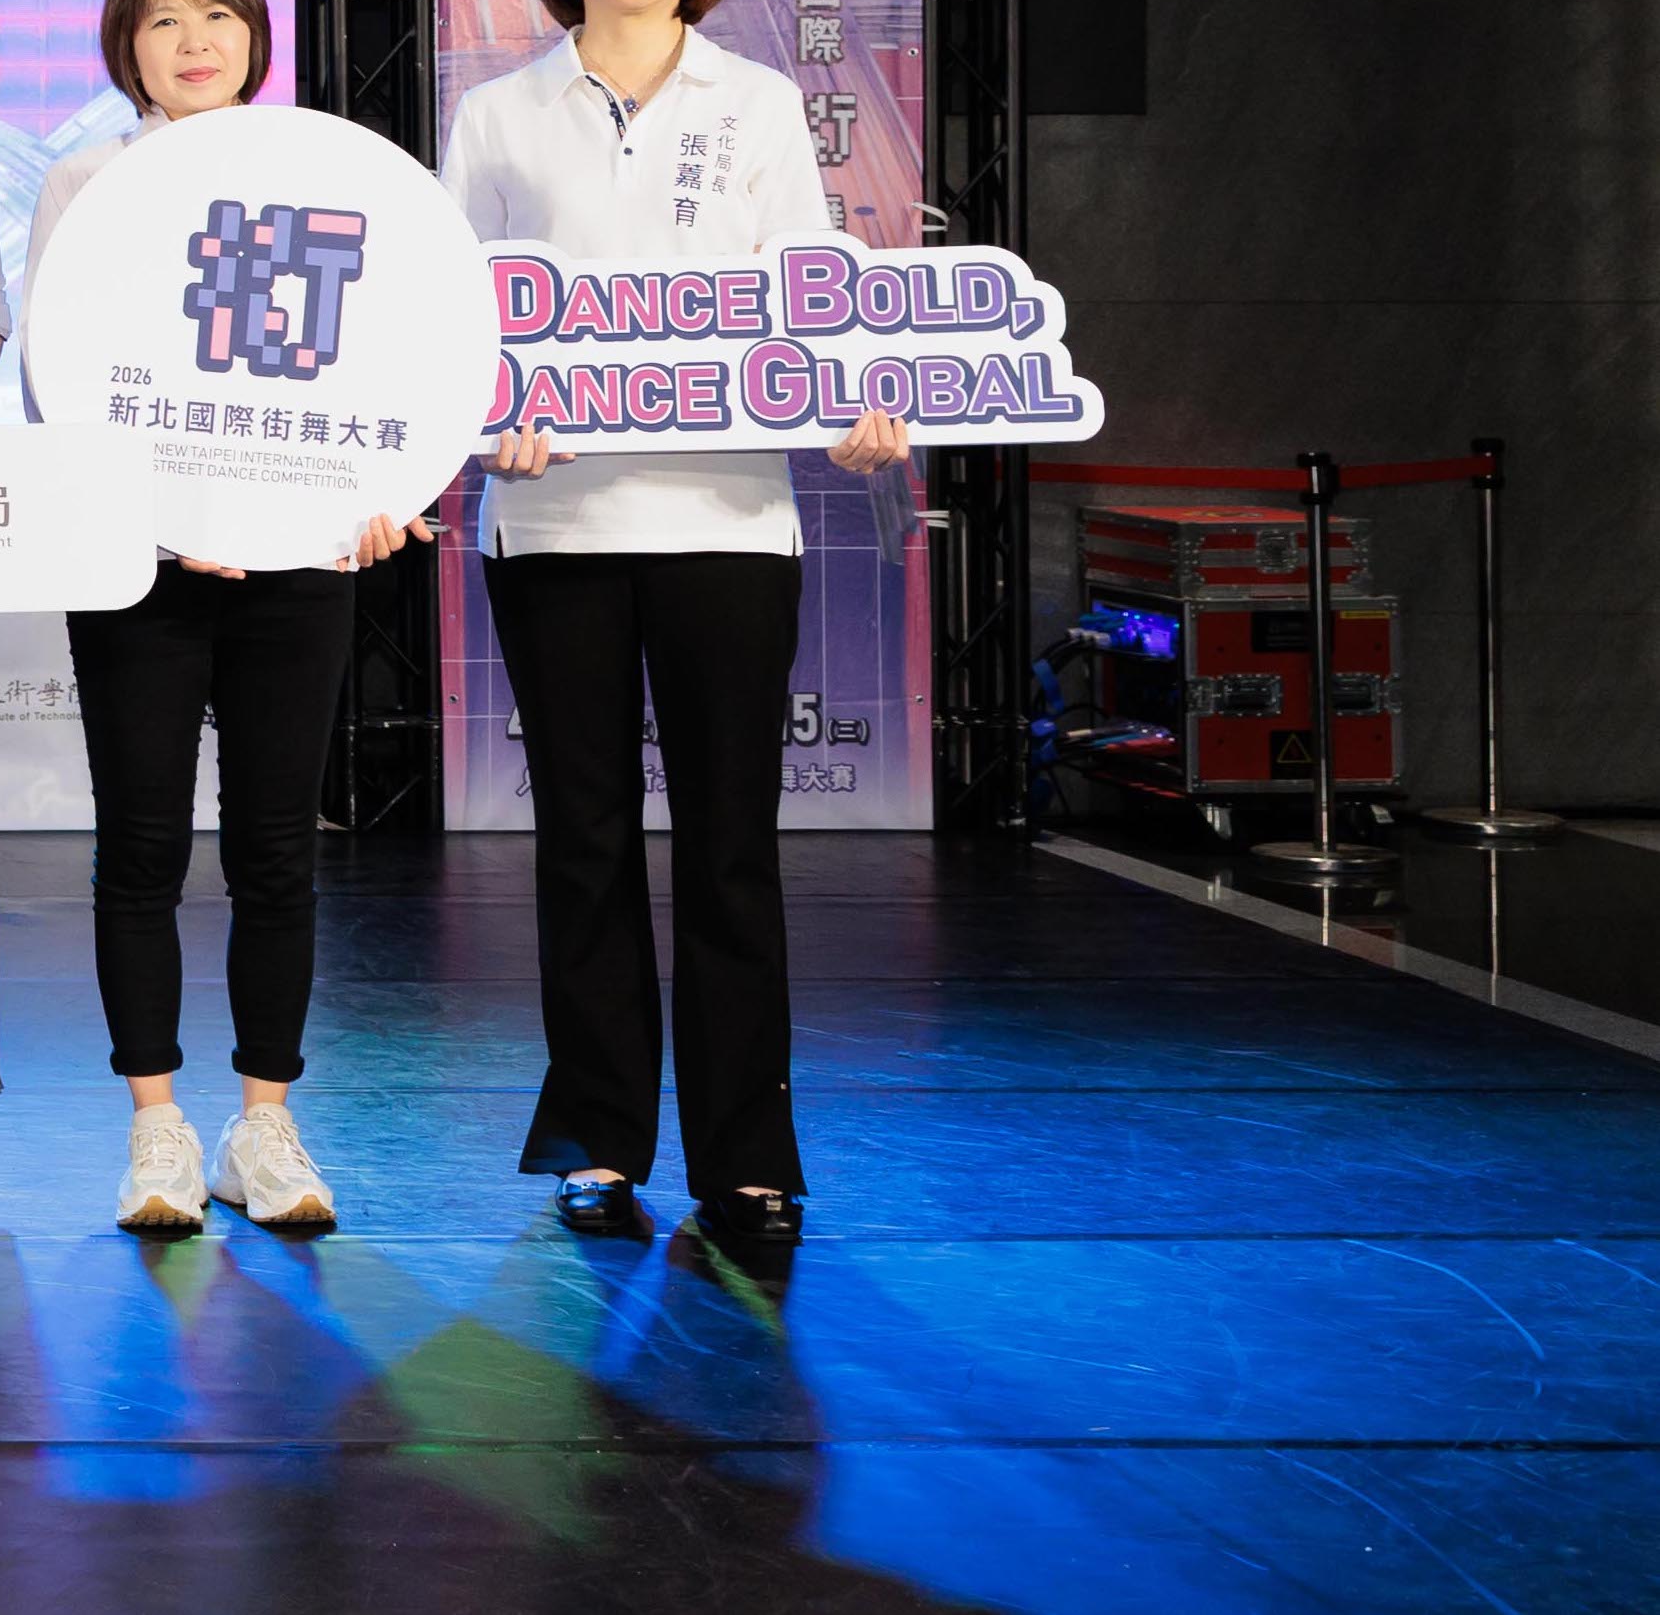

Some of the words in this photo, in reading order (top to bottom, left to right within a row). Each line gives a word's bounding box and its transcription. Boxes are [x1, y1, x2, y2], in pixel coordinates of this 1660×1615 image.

[712, 116, 738, 195] 文化局長
[110, 365, 152, 386] 2026
[108, 392, 409, 452] 新北國際街舞大賽
[154, 442, 189, 459] NEW
[190, 445, 237, 462] TAIPEI
[240, 450, 357, 474] INTERNATIONAL
[207, 463, 257, 482] DANCE
[260, 469, 359, 490] COMPETITION
